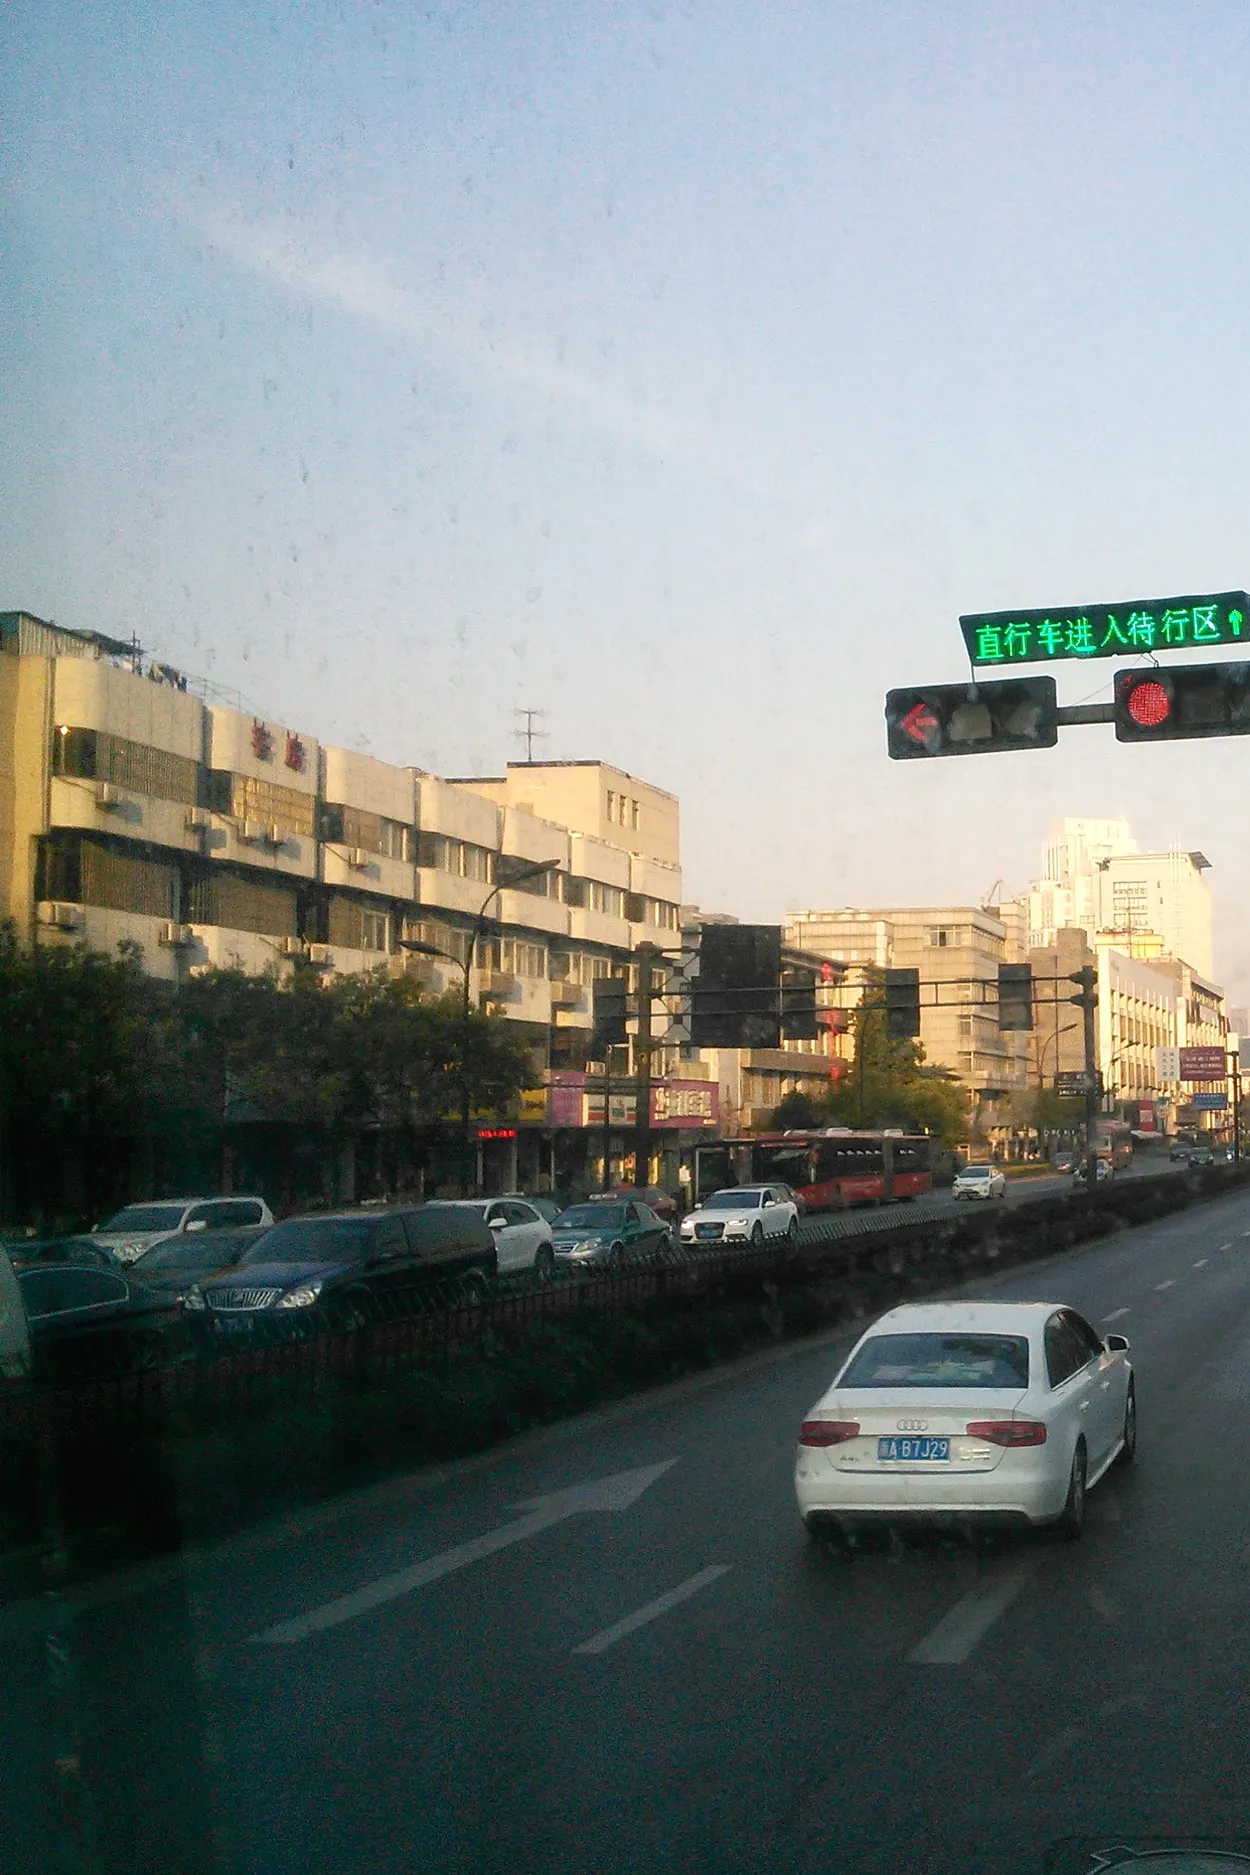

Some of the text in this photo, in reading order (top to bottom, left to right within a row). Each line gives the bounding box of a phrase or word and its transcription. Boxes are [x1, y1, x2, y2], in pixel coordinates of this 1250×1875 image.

[975, 605, 1221, 660] 直行车进入待行区
